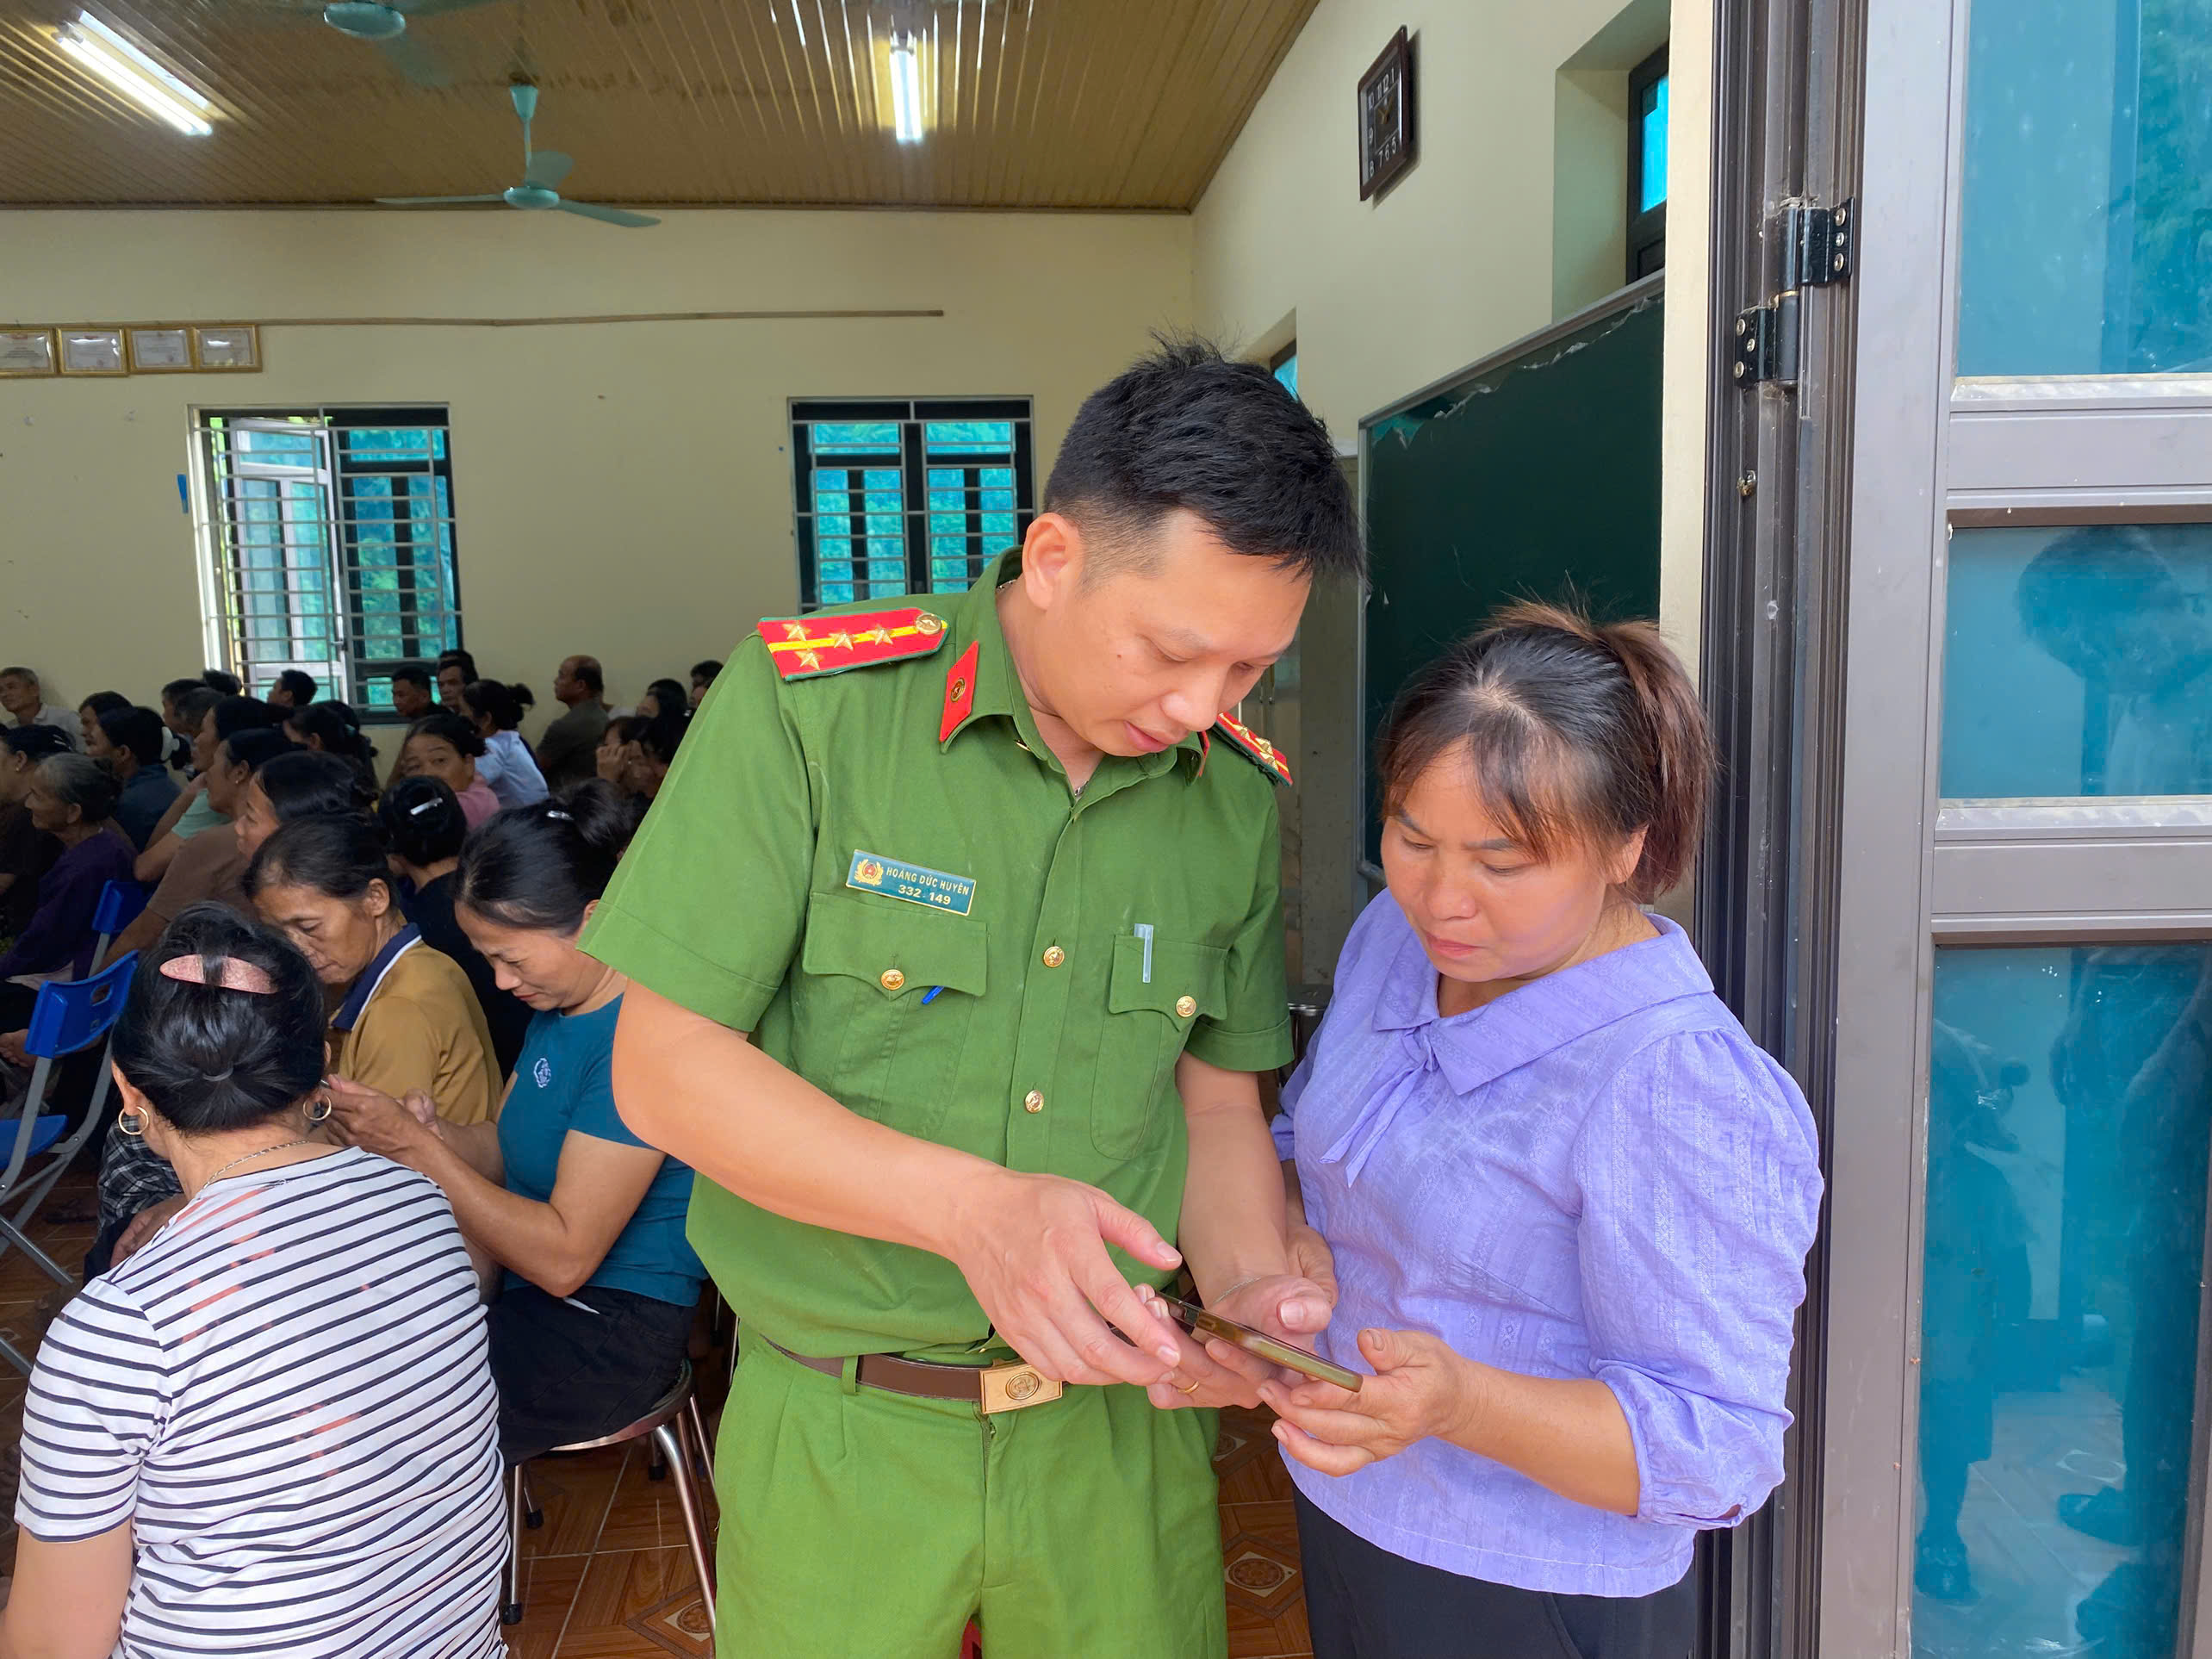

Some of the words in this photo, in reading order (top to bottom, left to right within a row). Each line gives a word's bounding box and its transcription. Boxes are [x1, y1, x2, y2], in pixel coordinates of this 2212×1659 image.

[1382, 73, 1389, 94] 12
[1369, 127, 1374, 147] 9
[1370, 160, 1375, 179] 8
[1378, 149, 1383, 169] 7
[1384, 143, 1390, 162] 6
[1391, 136, 1397, 155] 5
